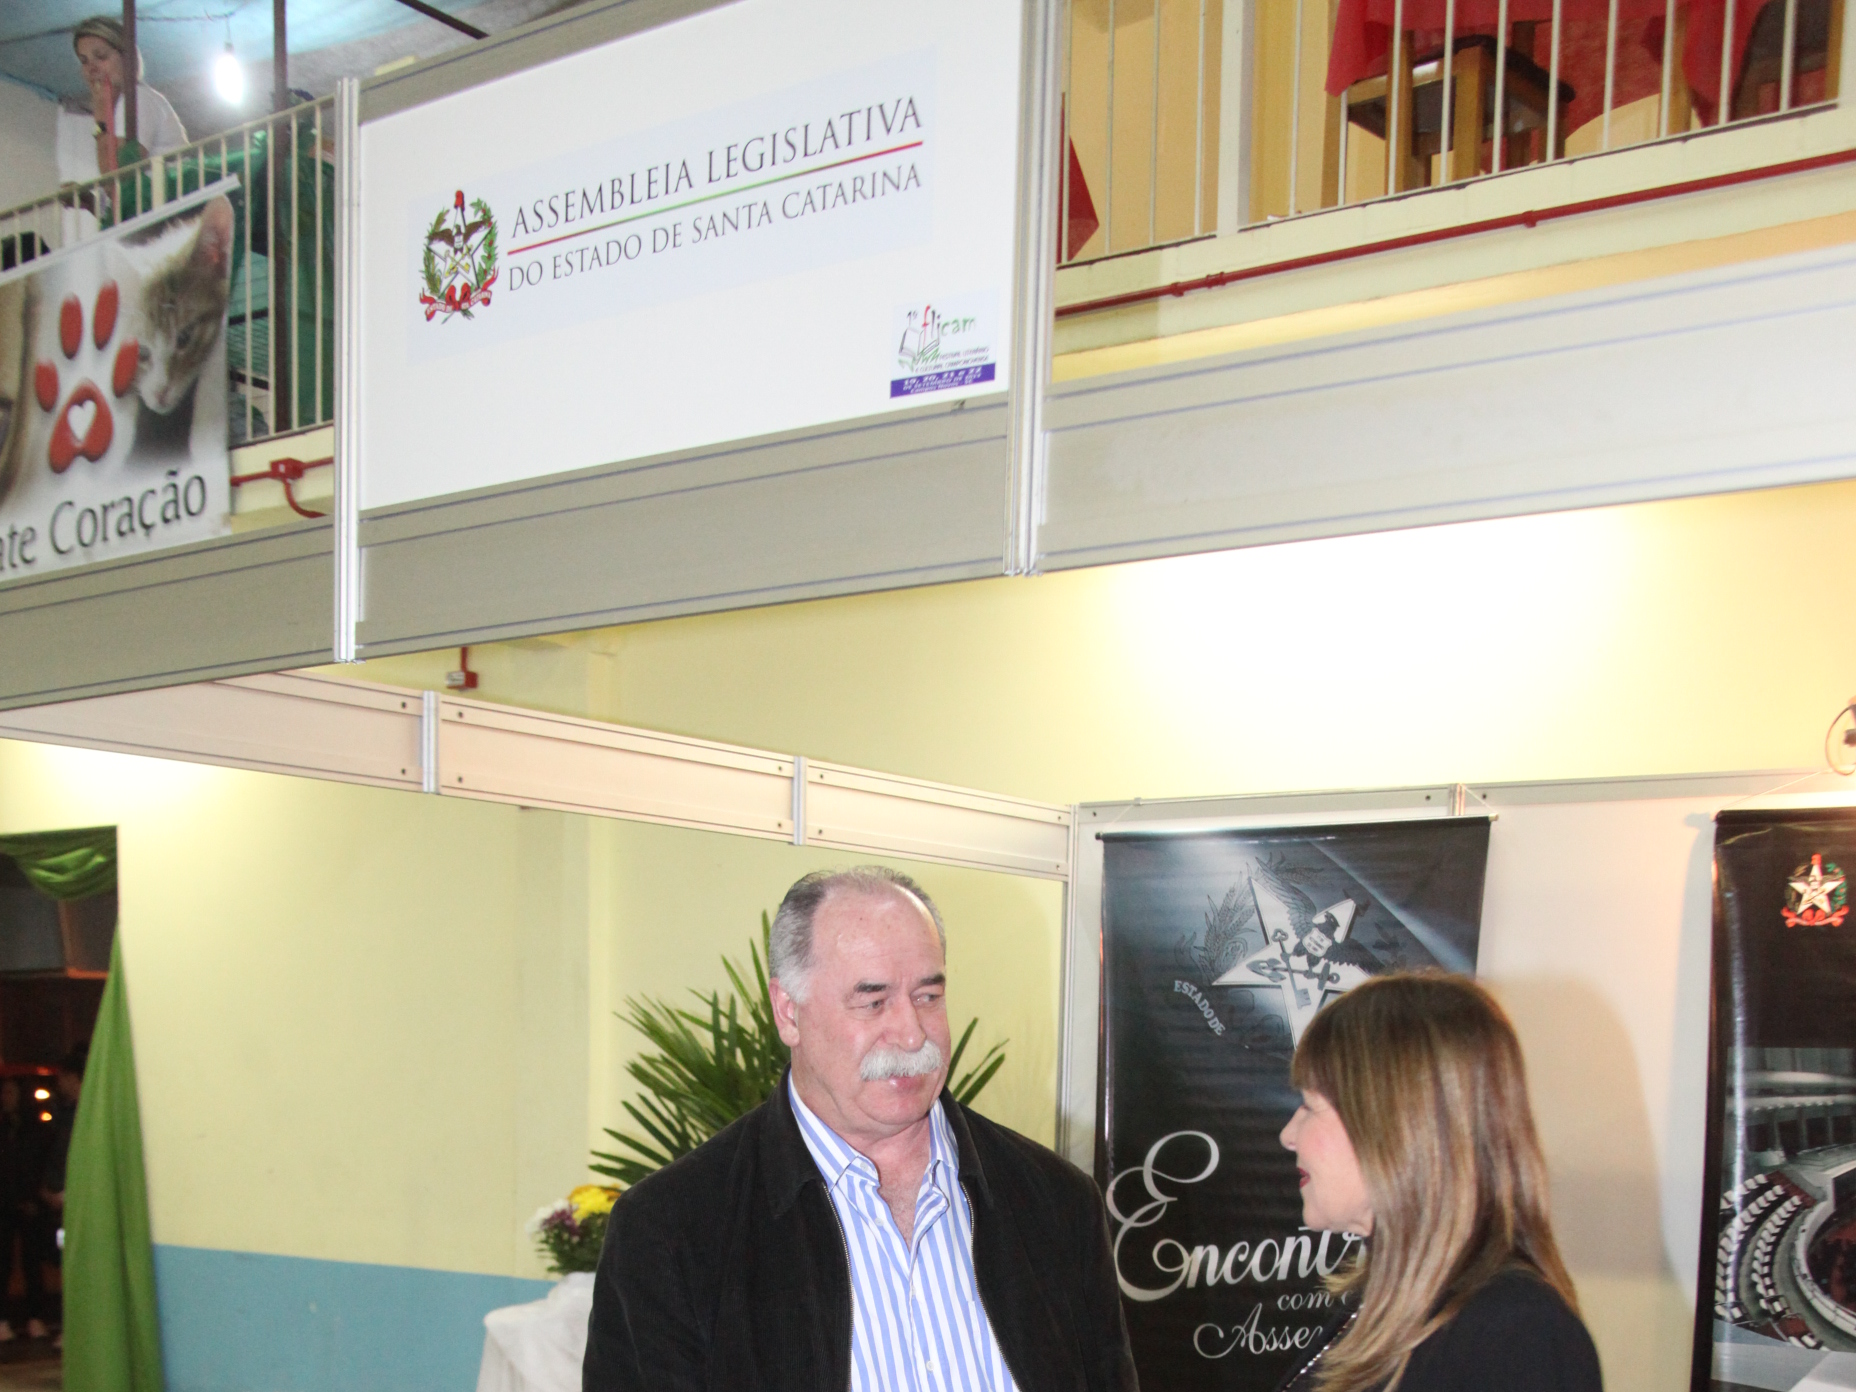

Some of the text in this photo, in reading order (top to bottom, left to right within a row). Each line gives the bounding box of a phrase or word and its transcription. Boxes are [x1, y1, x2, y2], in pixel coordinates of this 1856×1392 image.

[511, 95, 922, 239] ASSEMBLEIA LEGISLATIVA
[509, 162, 922, 292] DO ESTADO DE SANTA CATARINA
[50, 469, 207, 555] Coração
[1193, 1302, 1323, 1359] Asse
[1277, 1289, 1333, 1311] com
